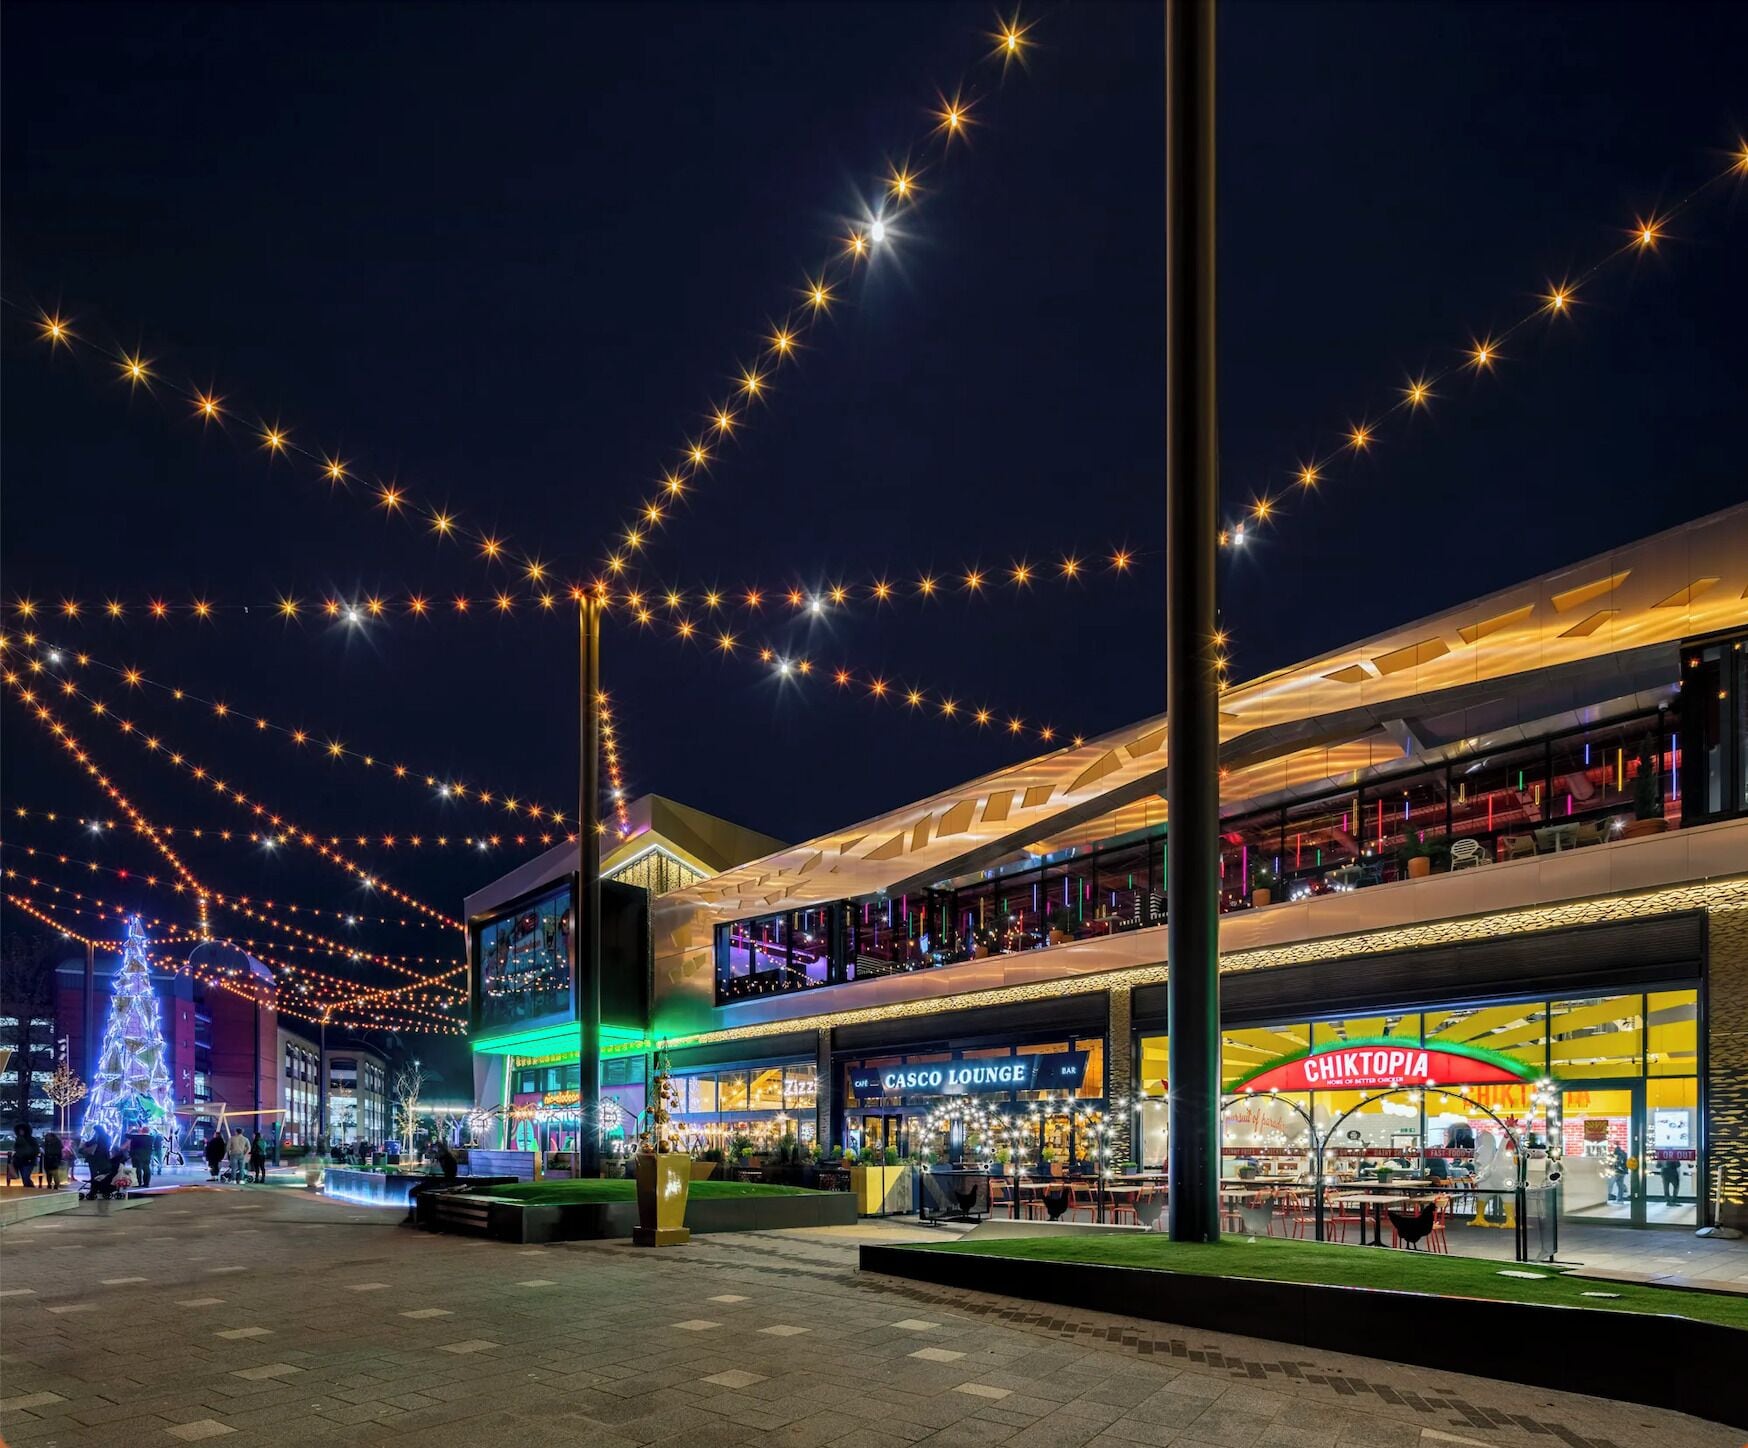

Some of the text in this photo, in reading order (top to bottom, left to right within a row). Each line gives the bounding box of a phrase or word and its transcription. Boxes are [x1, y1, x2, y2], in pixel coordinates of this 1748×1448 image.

[1061, 1066, 1076, 1075] BAR
[1303, 1051, 1428, 1082] CHIKTOPIA
[885, 1065, 1025, 1089] CASCO LOUNGE
[1662, 1151, 1673, 1159] OR
[1677, 1151, 1692, 1159] OUT
